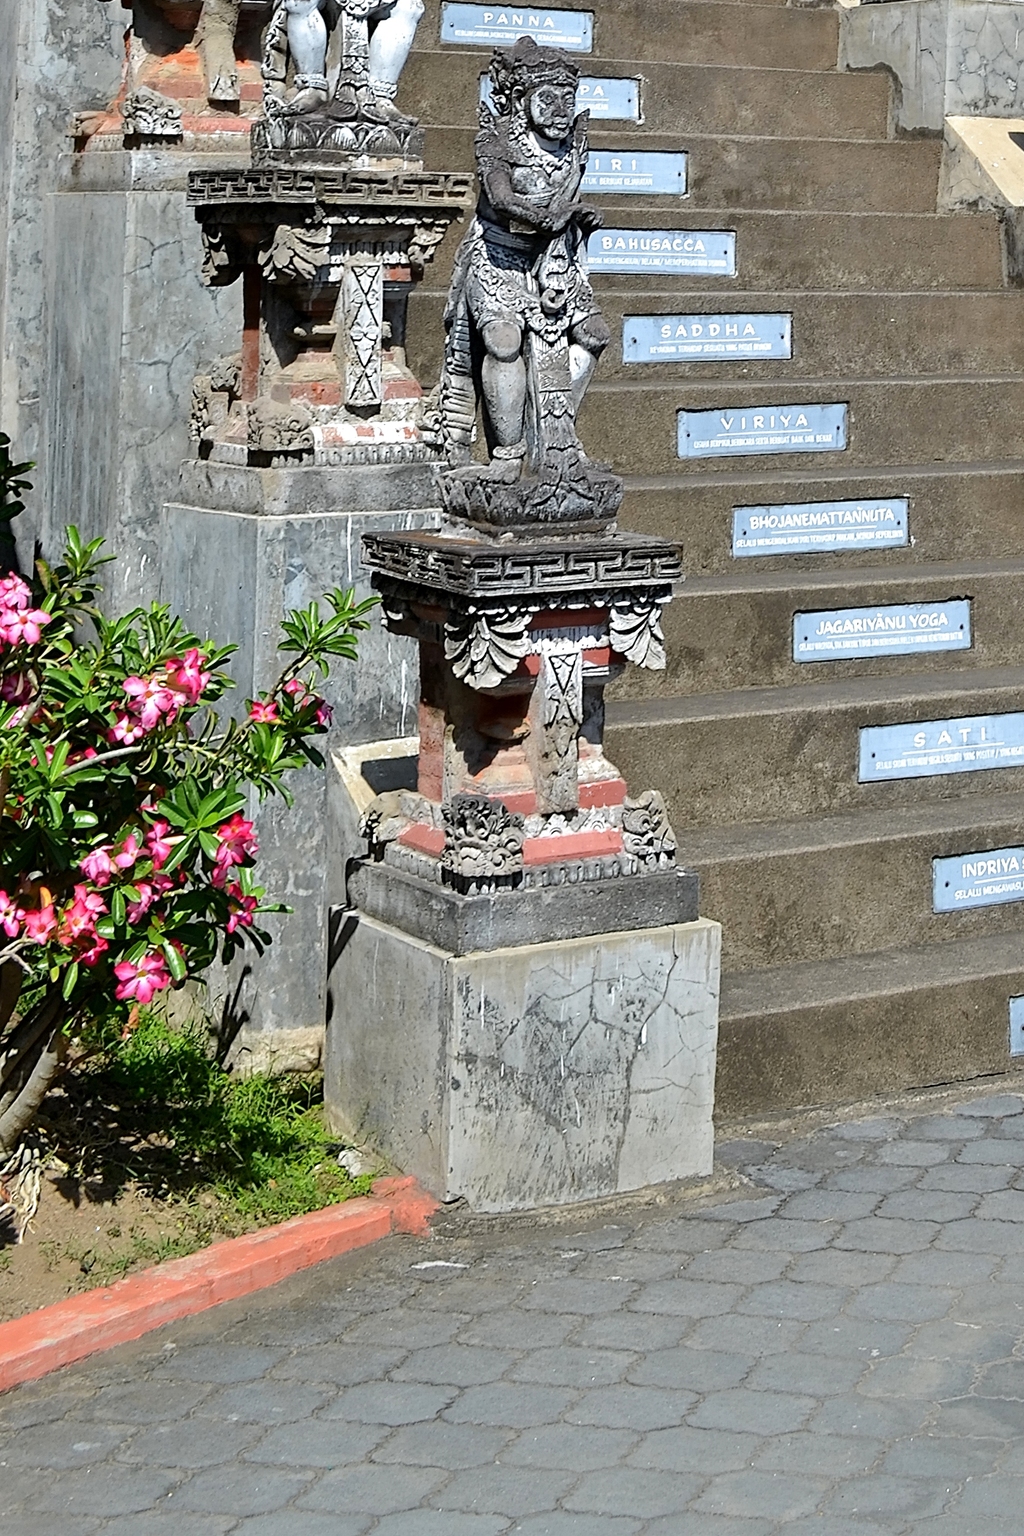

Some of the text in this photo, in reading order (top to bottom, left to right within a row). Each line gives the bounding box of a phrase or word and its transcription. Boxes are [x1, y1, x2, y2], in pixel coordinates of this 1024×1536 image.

[484, 12, 554, 28] PANNA
[602, 236, 705, 252] BAHUSACCA
[661, 323, 755, 338] SADDHA
[720, 413, 808, 430] VIRIYA
[909, 612, 948, 629] YOGA
[913, 726, 986, 748] SATI
[962, 856, 1019, 878] INDRIYA
[954, 887, 981, 900] SELALU
